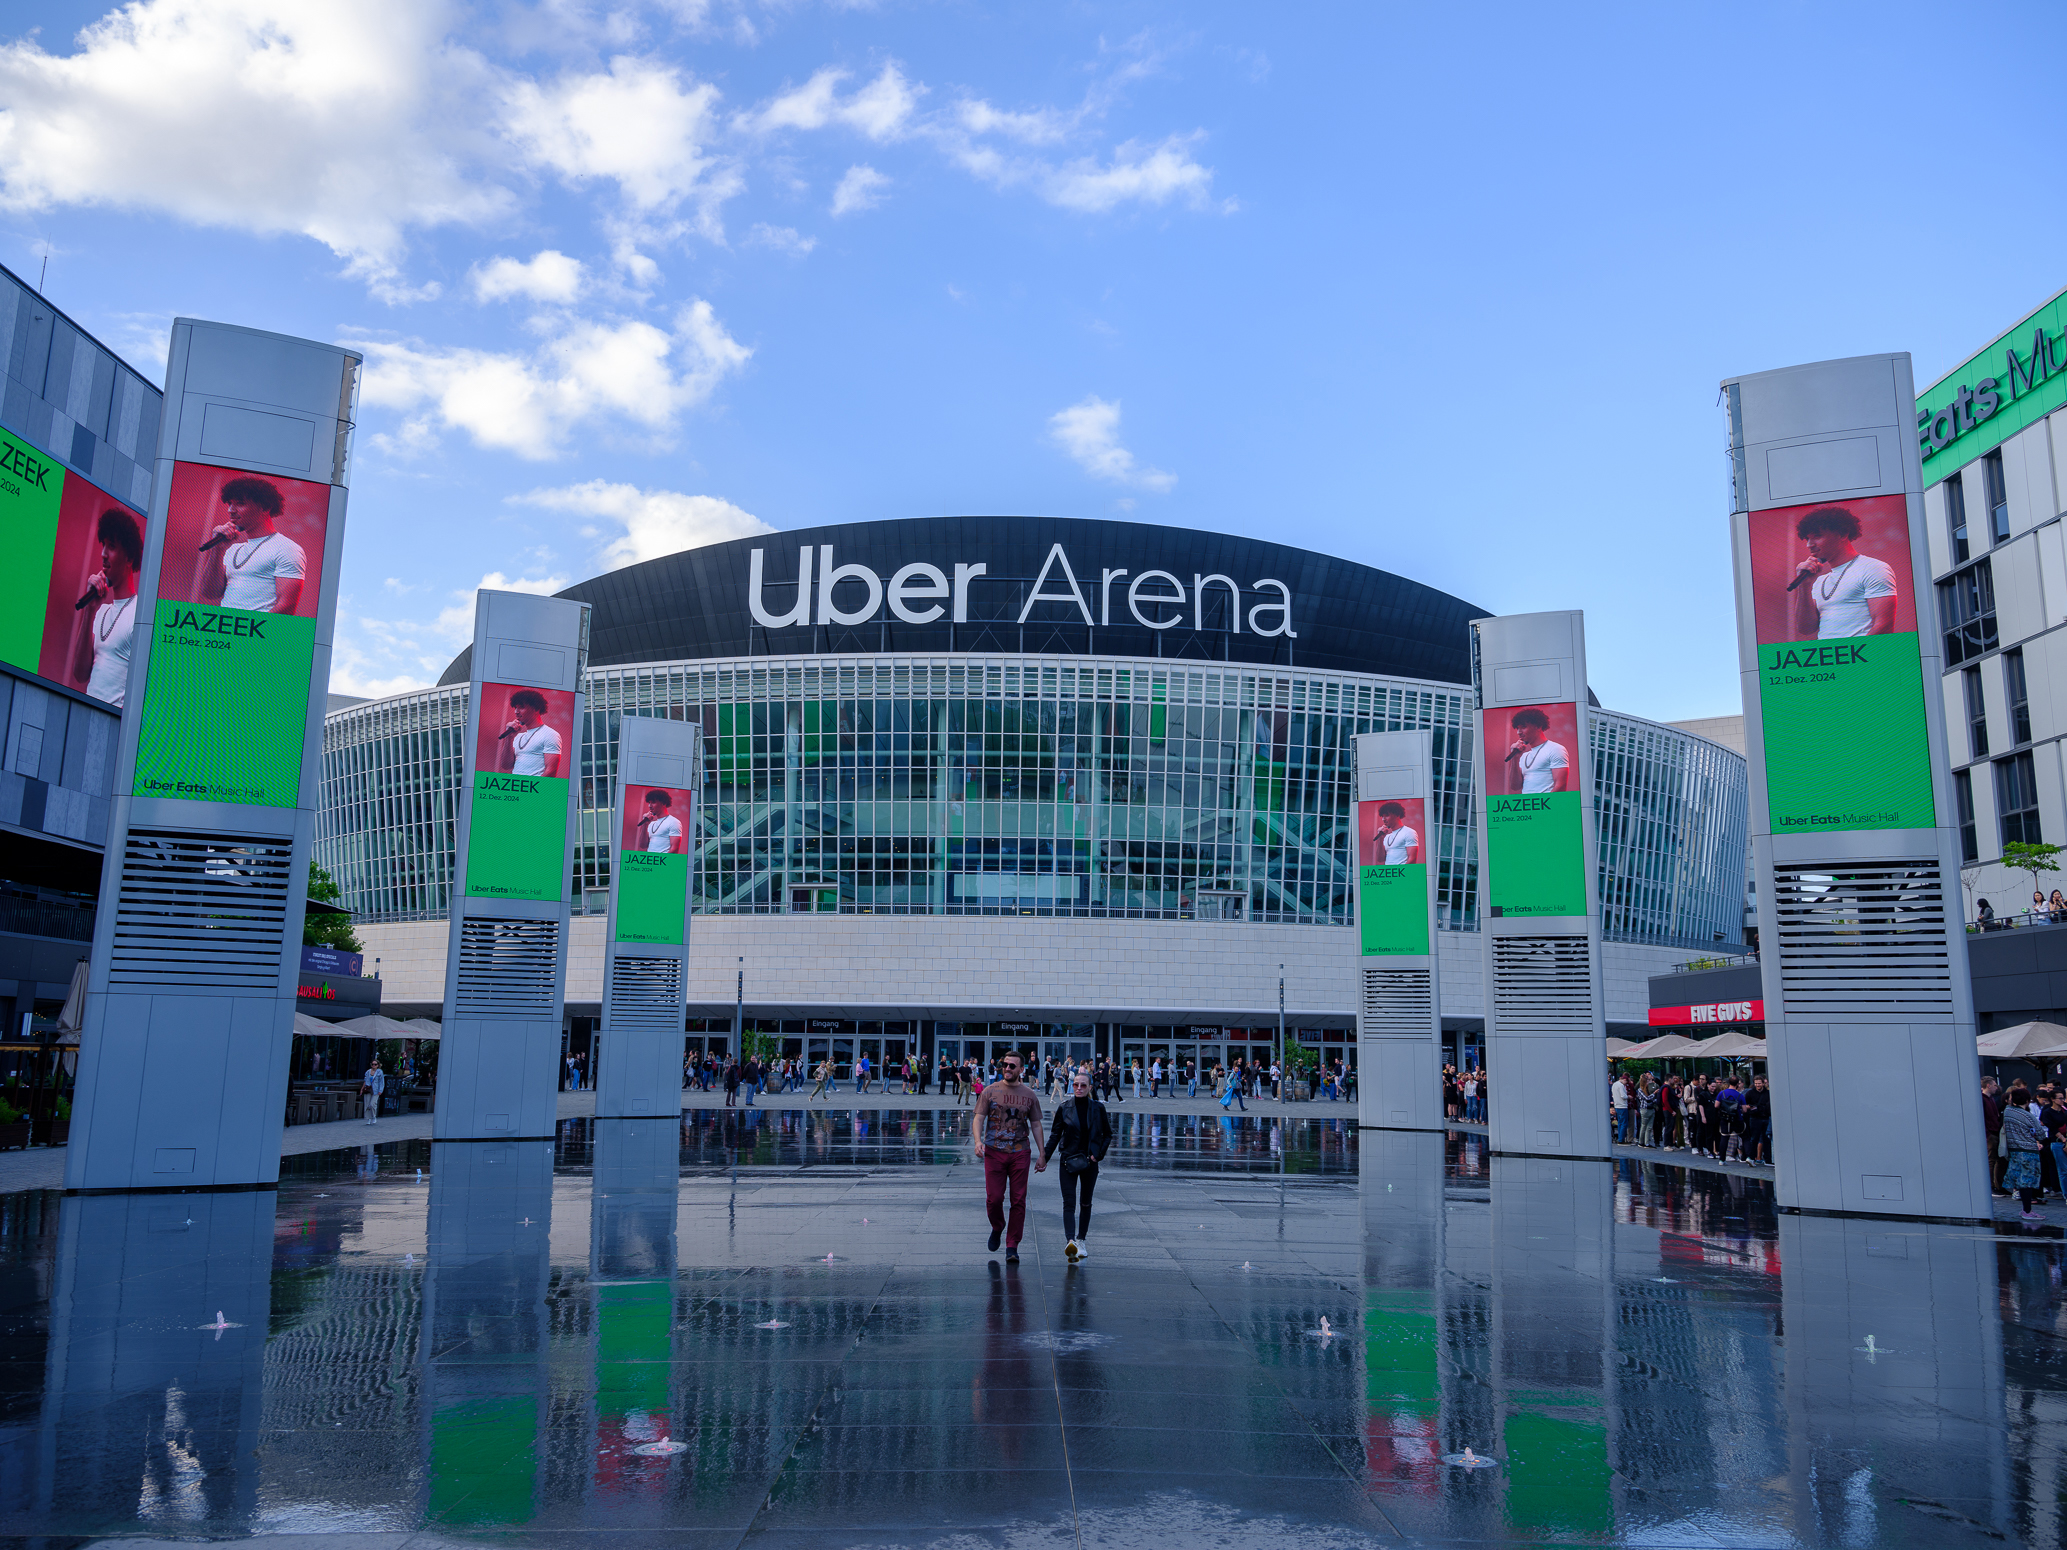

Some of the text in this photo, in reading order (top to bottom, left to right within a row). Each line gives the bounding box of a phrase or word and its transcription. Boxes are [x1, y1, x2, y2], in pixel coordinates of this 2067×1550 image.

[1, 478, 20, 497] 2024
[748, 543, 1298, 639] Uber Arena
[164, 609, 267, 639] JAZEEK
[162, 634, 231, 650] 12. Dez. 2024
[1768, 643, 1869, 671] JAZEEK
[1769, 672, 1836, 685] 12. Dez. 2024
[143, 779, 265, 798] Uber Eats Music Hall
[480, 777, 540, 793] JAZEEK
[1492, 797, 1551, 813] JAZEEK
[1779, 811, 1899, 826] Uber Eats Music Hall
[625, 854, 667, 866] JAZEEK
[1364, 868, 1406, 878] JAZEEK
[509, 887, 529, 895] Music
[1514, 905, 1532, 913] Eats
[1554, 904, 1566, 912] Hall
[1690, 1001, 1753, 1023] FIVE GUYS
[812, 1019, 839, 1028] Eingang
[1001, 1022, 1029, 1031] Eingang
[1190, 1026, 1218, 1034] Eingang
